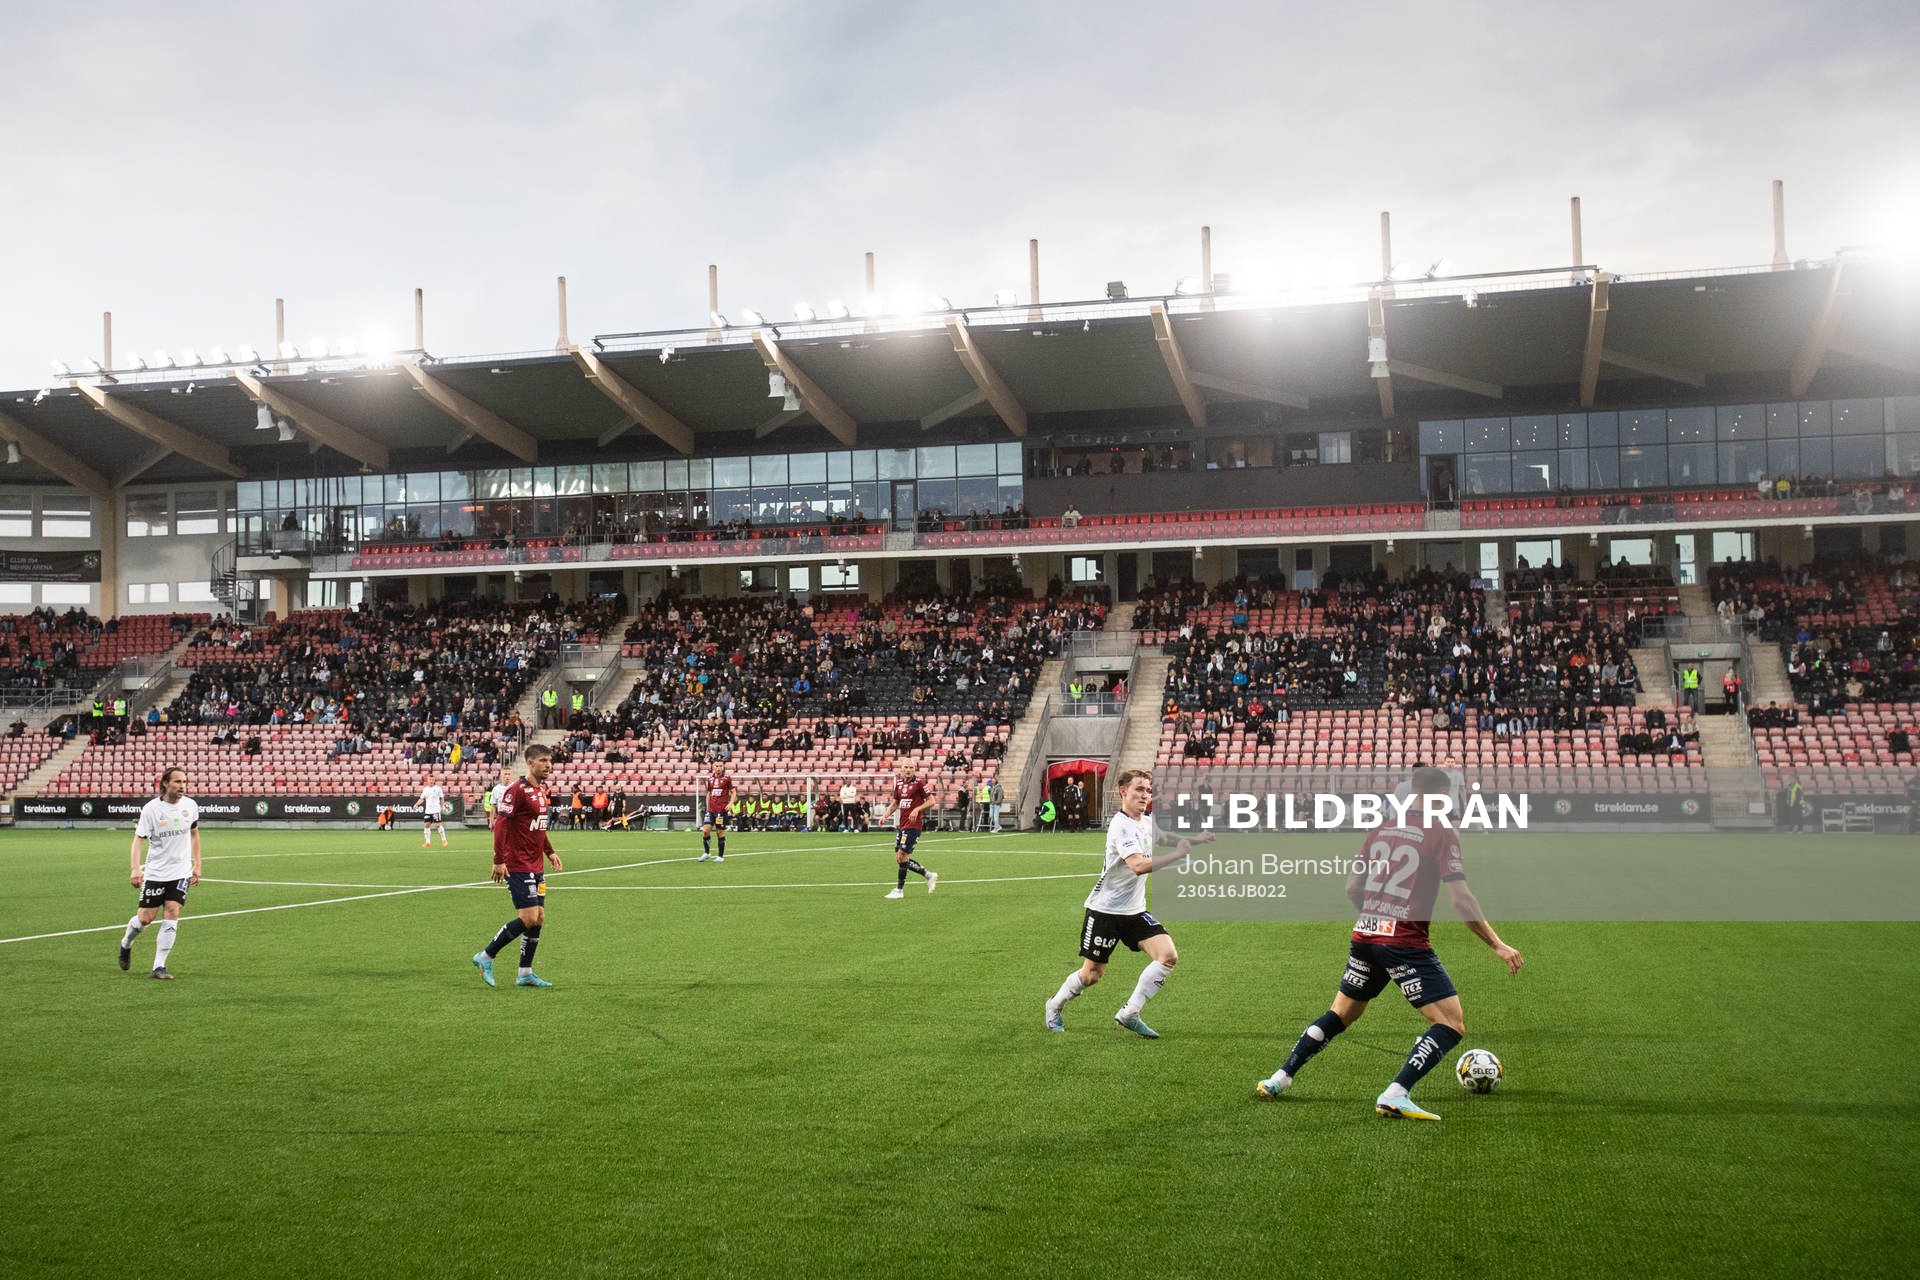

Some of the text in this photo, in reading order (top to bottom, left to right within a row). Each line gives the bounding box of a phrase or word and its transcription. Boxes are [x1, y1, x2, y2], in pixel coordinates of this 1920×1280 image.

[24, 804, 67, 814] tsreklam.se
[107, 804, 141, 814] tsreklam
[198, 804, 240, 814] sreklam.se
[284, 804, 331, 814] tsreklam.se
[1594, 802, 1659, 813] tsreklam.se
[1365, 841, 1420, 900] 22
[1472, 1067, 1497, 1076] SELECT
